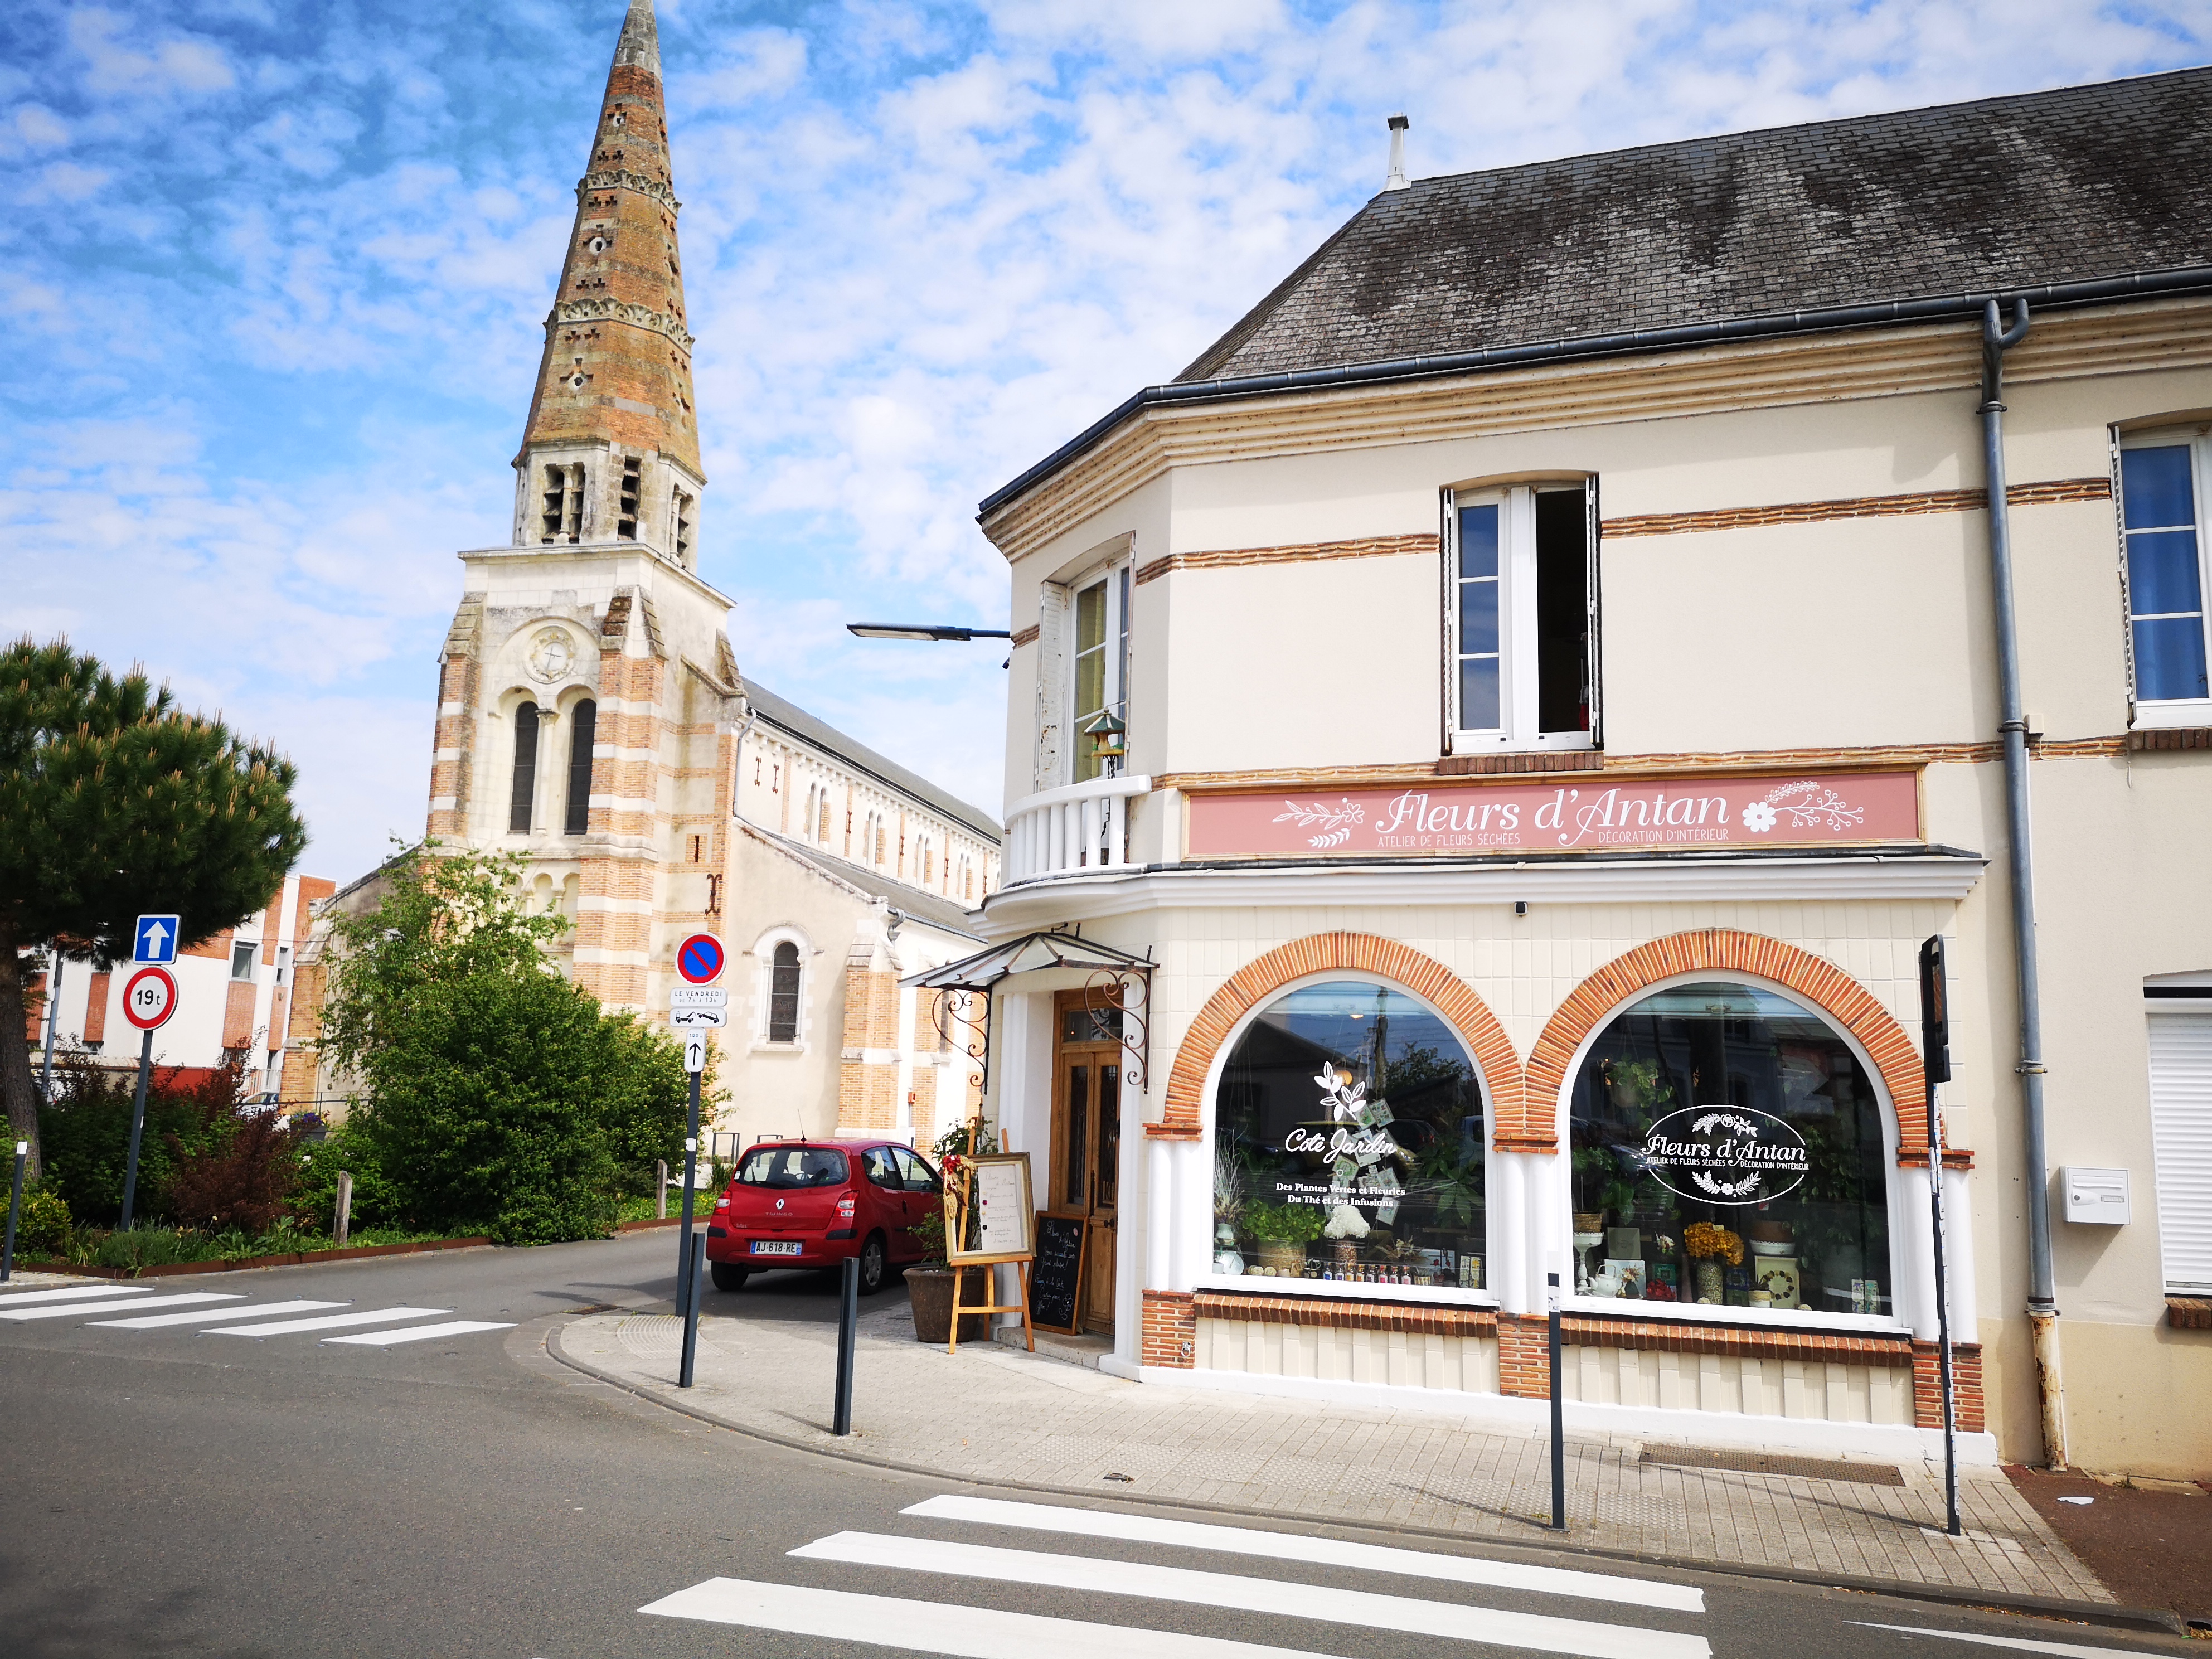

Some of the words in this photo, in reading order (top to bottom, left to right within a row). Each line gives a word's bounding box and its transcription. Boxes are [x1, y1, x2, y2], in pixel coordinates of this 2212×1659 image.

[1375, 789, 1520, 833] Fleurs
[1535, 788, 1730, 847] d'Antan
[1377, 835, 1415, 847] ATELIER
[1420, 835, 1432, 846] DE
[1437, 833, 1473, 846] FLEURS
[1478, 831, 1520, 845] SÉCHÉES
[1599, 830, 1663, 843] DÉCORATION
[1667, 827, 1729, 842] D'INTÉRIEUR
[1323, 1128, 1397, 1164] Jardin
[1641, 1133, 1711, 1157] Fleurs
[1716, 1138, 1806, 1167] d'Antan
[1702, 1158, 1726, 1167] SÉCHÉES
[1740, 1160, 1774, 1169] DÉCORATION
[1777, 1162, 1809, 1170] D'INTÉRIEUR
[1276, 1182, 1293, 1191] Des
[1294, 1183, 1327, 1192] Plantes
[1329, 1185, 1356, 1194] Vertes
[1369, 1186, 1405, 1195] Fleuries
[1303, 1195, 1320, 1204] Thé
[1350, 1197, 1394, 1206] Infusions
[756, 1242, 796, 1253] AJ-618-RE
